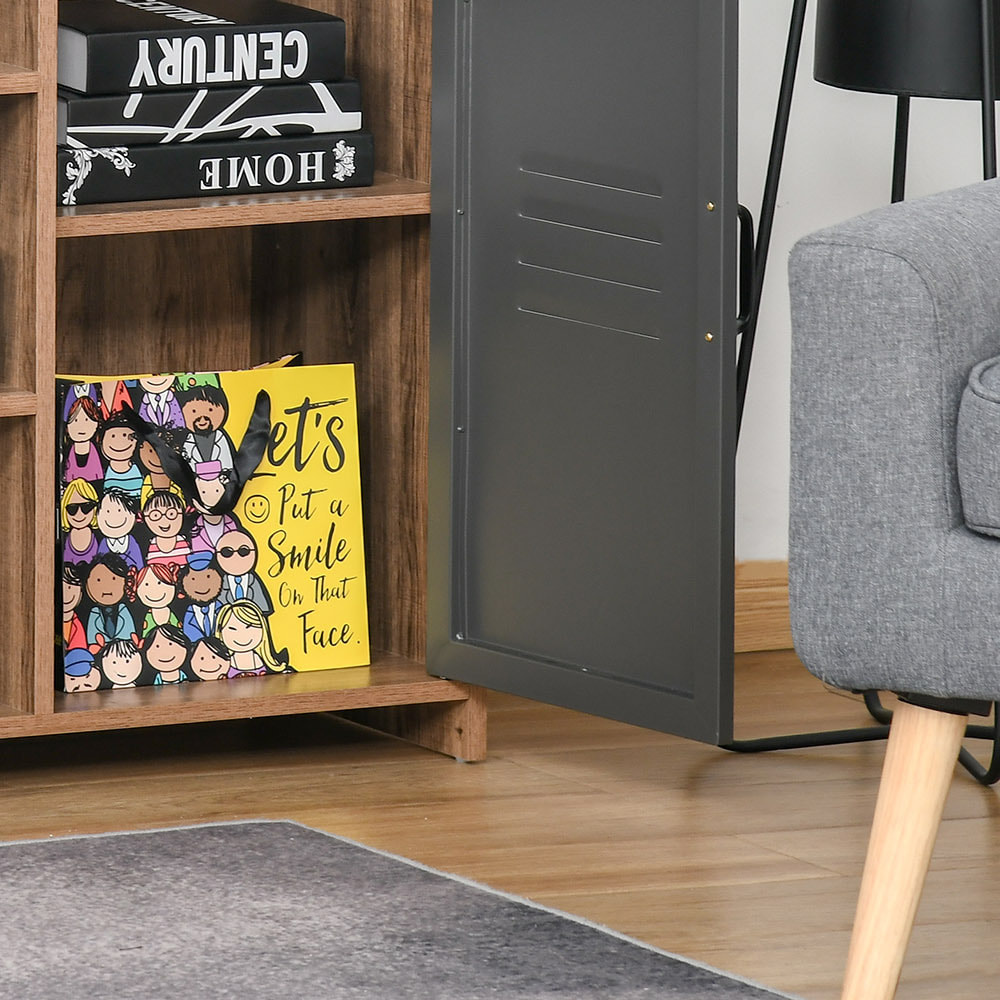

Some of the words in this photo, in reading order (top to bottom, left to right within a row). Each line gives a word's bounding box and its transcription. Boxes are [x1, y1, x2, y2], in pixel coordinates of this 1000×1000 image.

[129, 30, 308, 87] CENTURY
[199, 151, 326, 190] HOME
[247, 396, 349, 481] et's
[278, 482, 329, 526] Put
[329, 499, 350, 518] a
[267, 521, 352, 578] Smile
[278, 581, 304, 608] On
[310, 574, 358, 604] That
